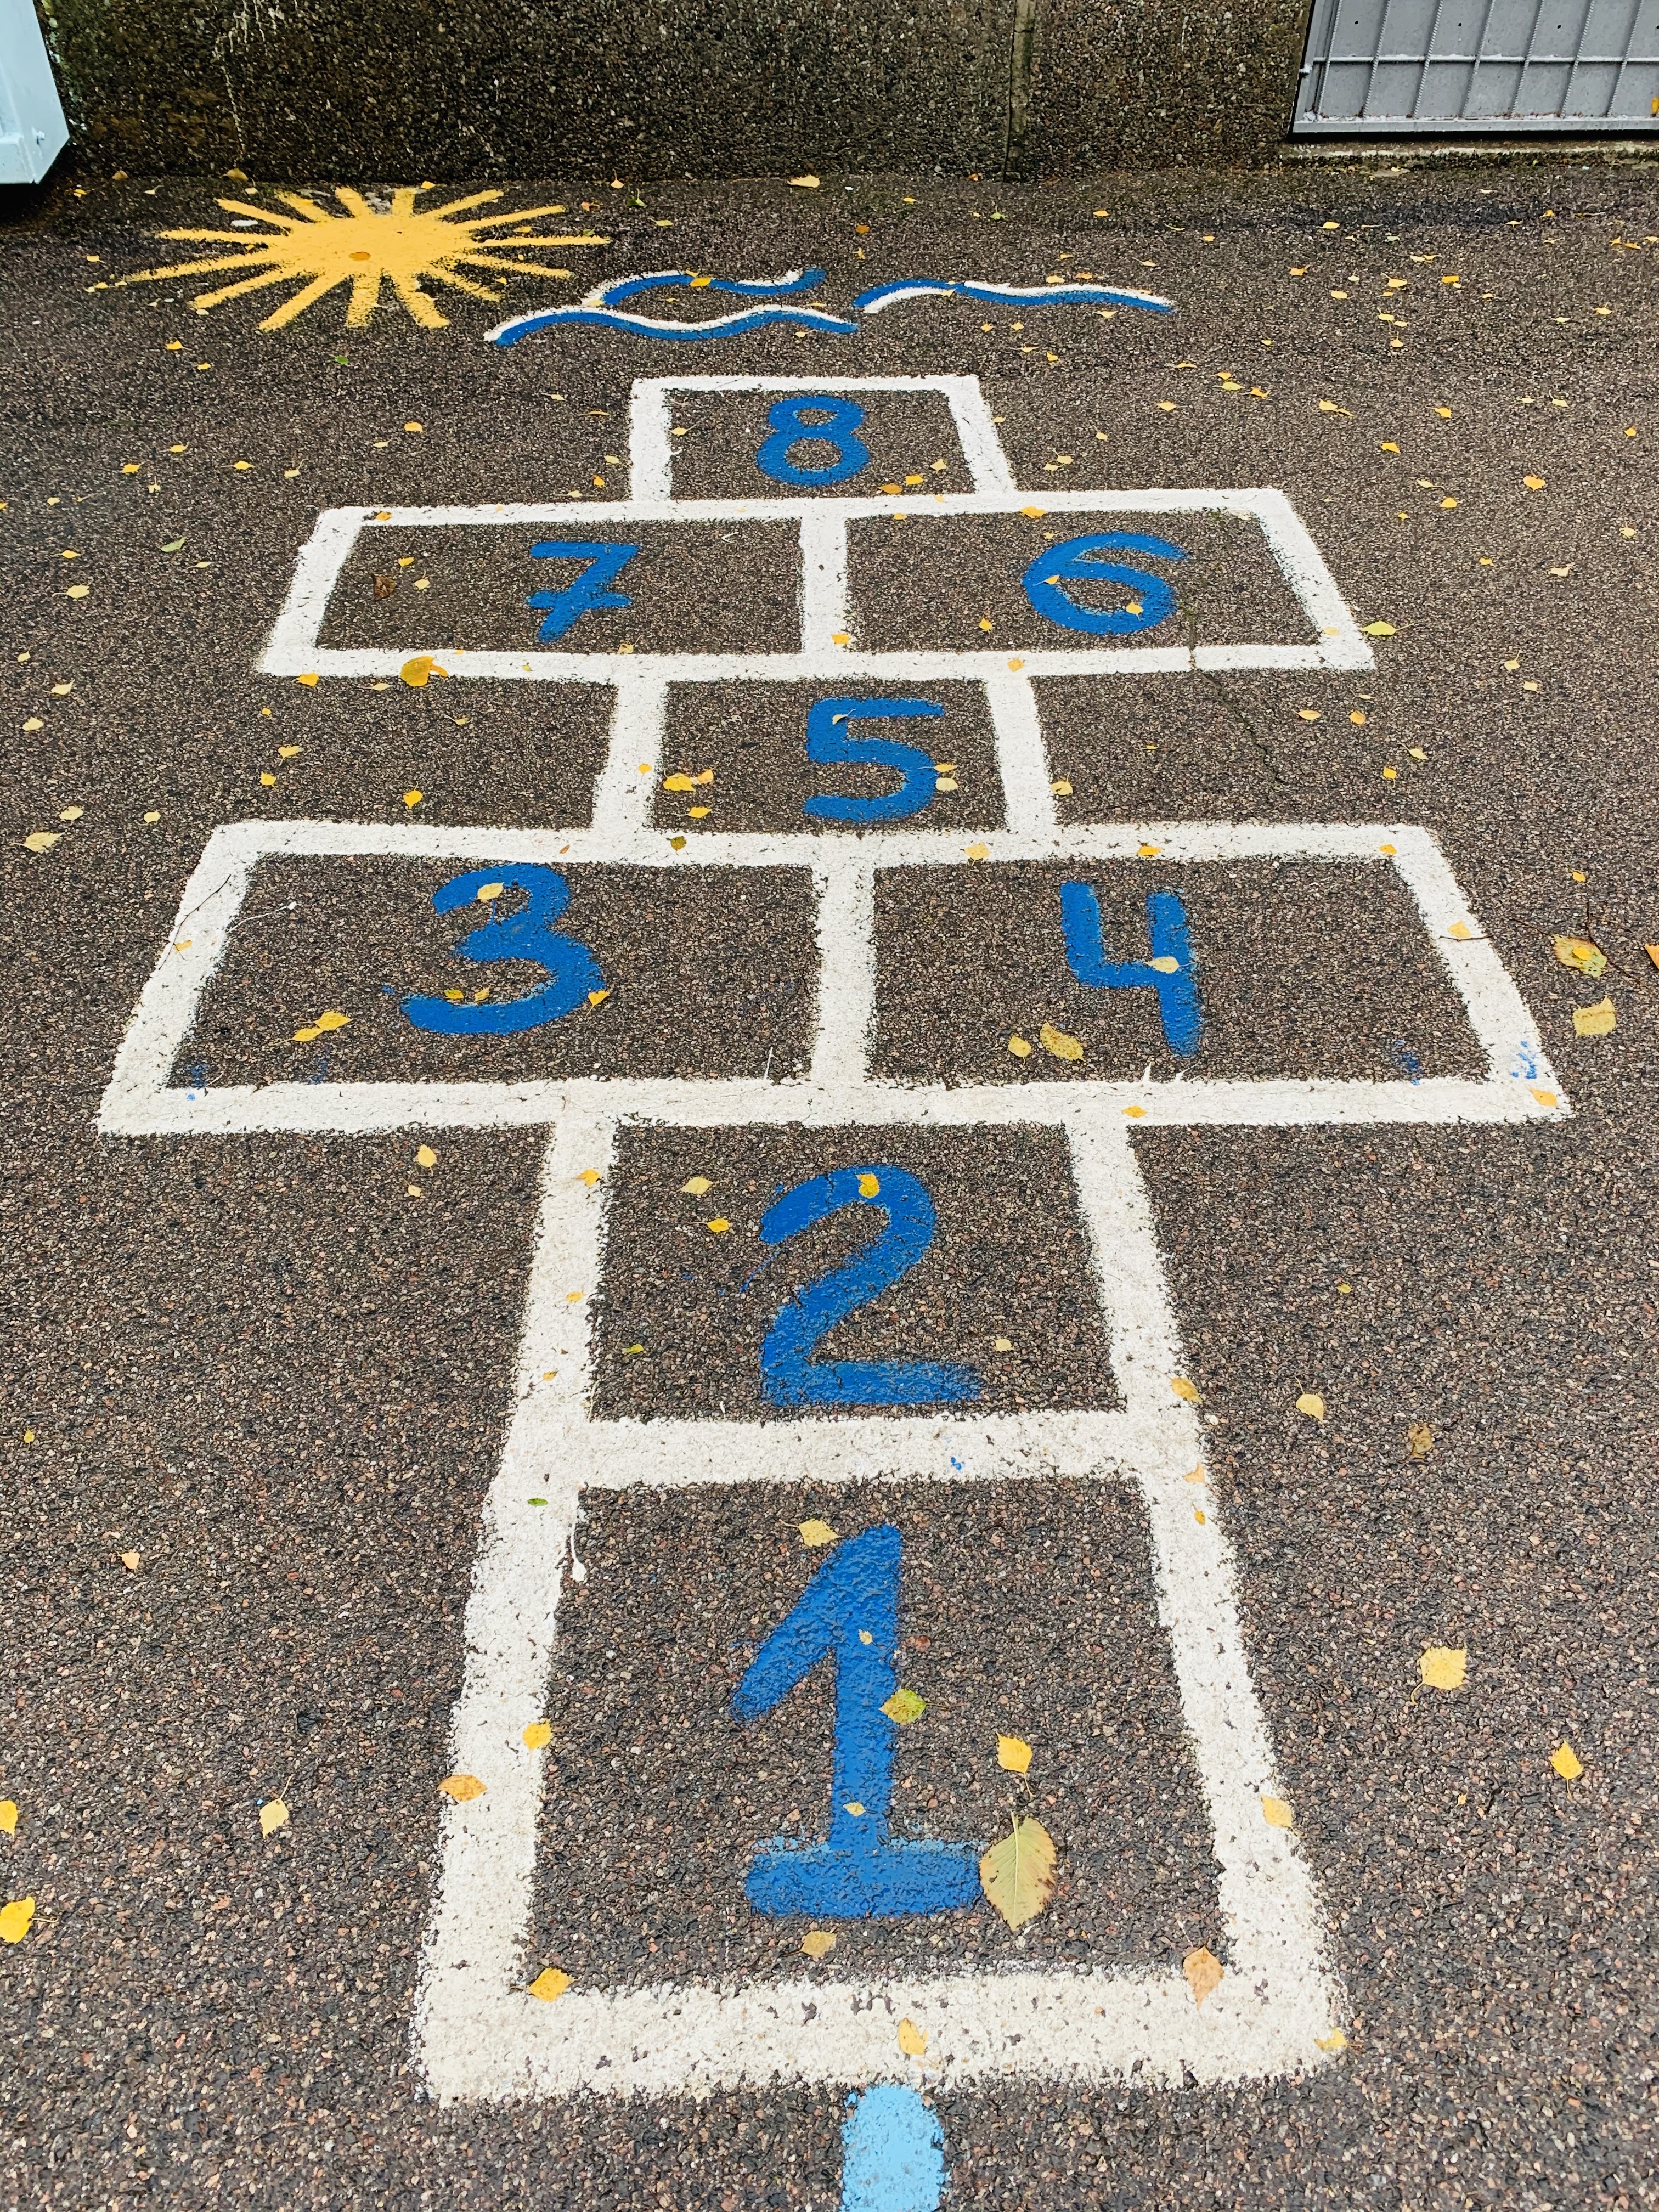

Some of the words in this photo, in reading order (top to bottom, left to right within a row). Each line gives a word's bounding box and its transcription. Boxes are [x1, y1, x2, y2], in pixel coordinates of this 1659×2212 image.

[757, 395, 869, 487] 8
[528, 540, 639, 642] 7
[1022, 531, 1181, 635] 6
[804, 697, 944, 822] 5
[401, 863, 605, 1035] 3
[1059, 881, 1200, 1054] 4
[760, 1164, 979, 1407] 2
[733, 1523, 982, 1918] 1
